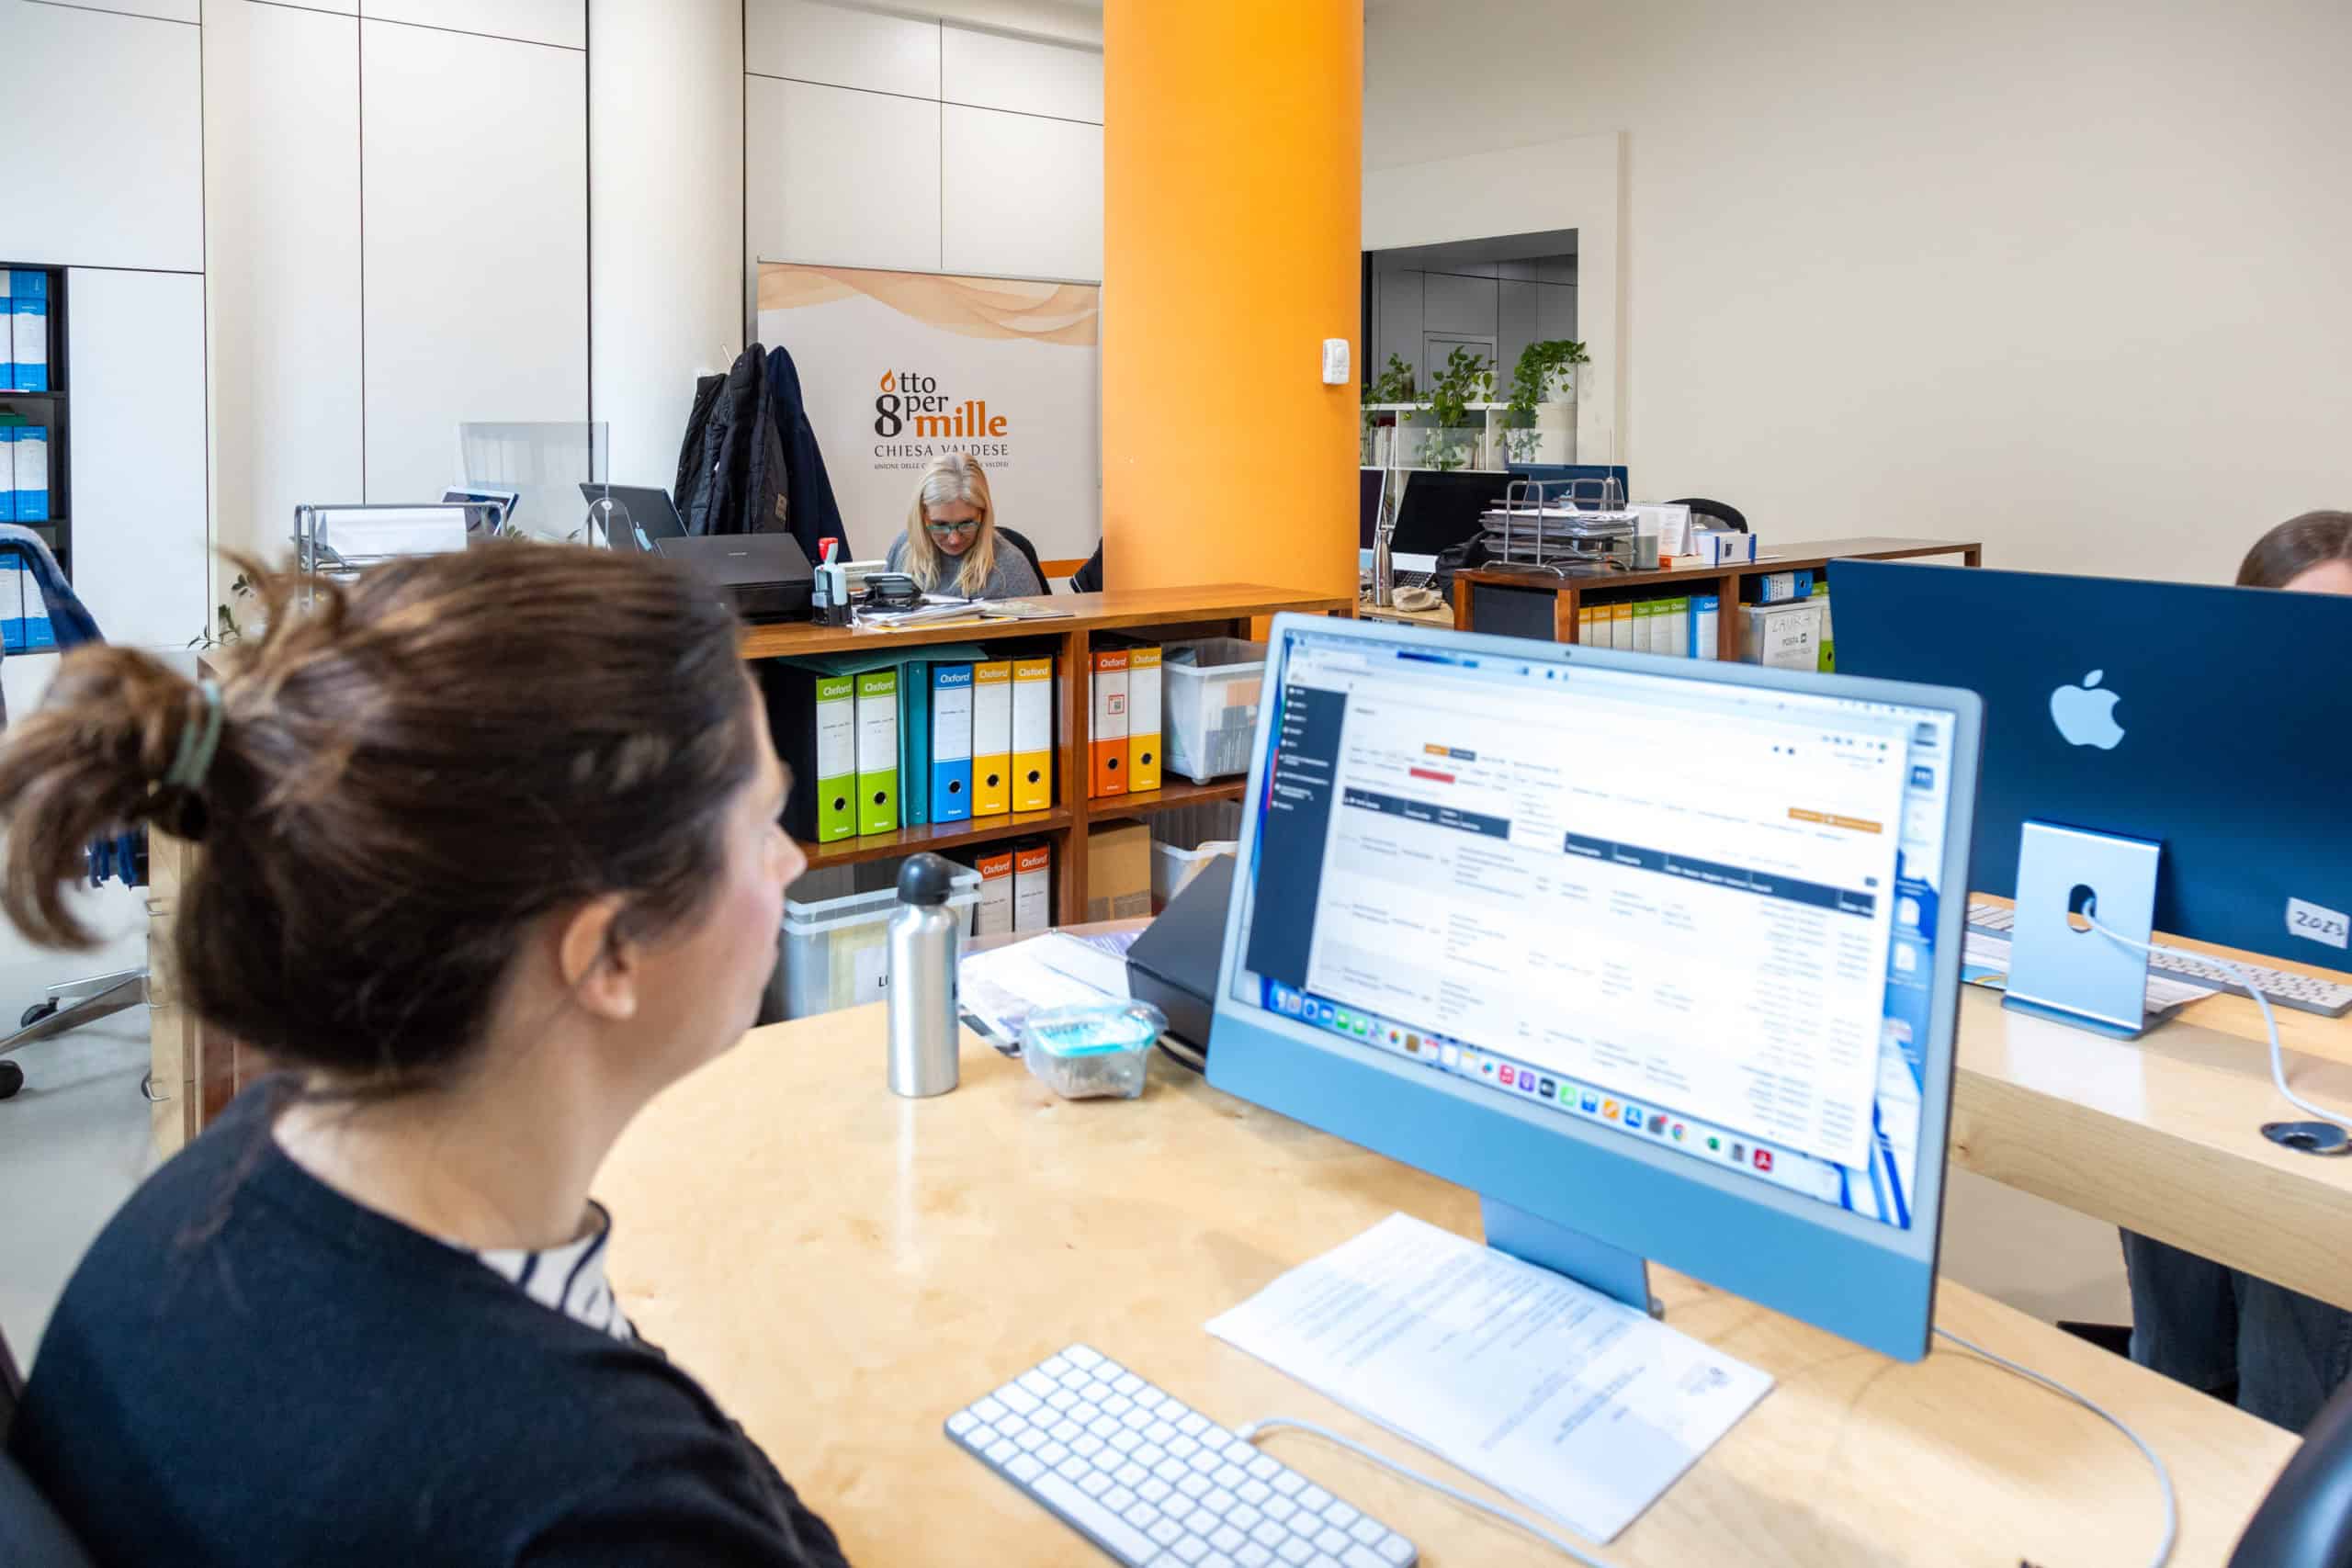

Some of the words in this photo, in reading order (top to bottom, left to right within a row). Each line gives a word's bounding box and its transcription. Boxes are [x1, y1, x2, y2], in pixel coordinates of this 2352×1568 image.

[875, 394, 902, 437] 8
[904, 395, 949, 422] per
[913, 400, 1008, 437] mille
[875, 445, 933, 457] CHIESA
[1101, 658, 1127, 668] Oxford
[940, 672, 970, 683] Oxford
[823, 683, 853, 696] Oxford
[865, 680, 895, 692] Oxford
[983, 860, 1011, 874] Oxford
[1021, 853, 1048, 868] Oxford
